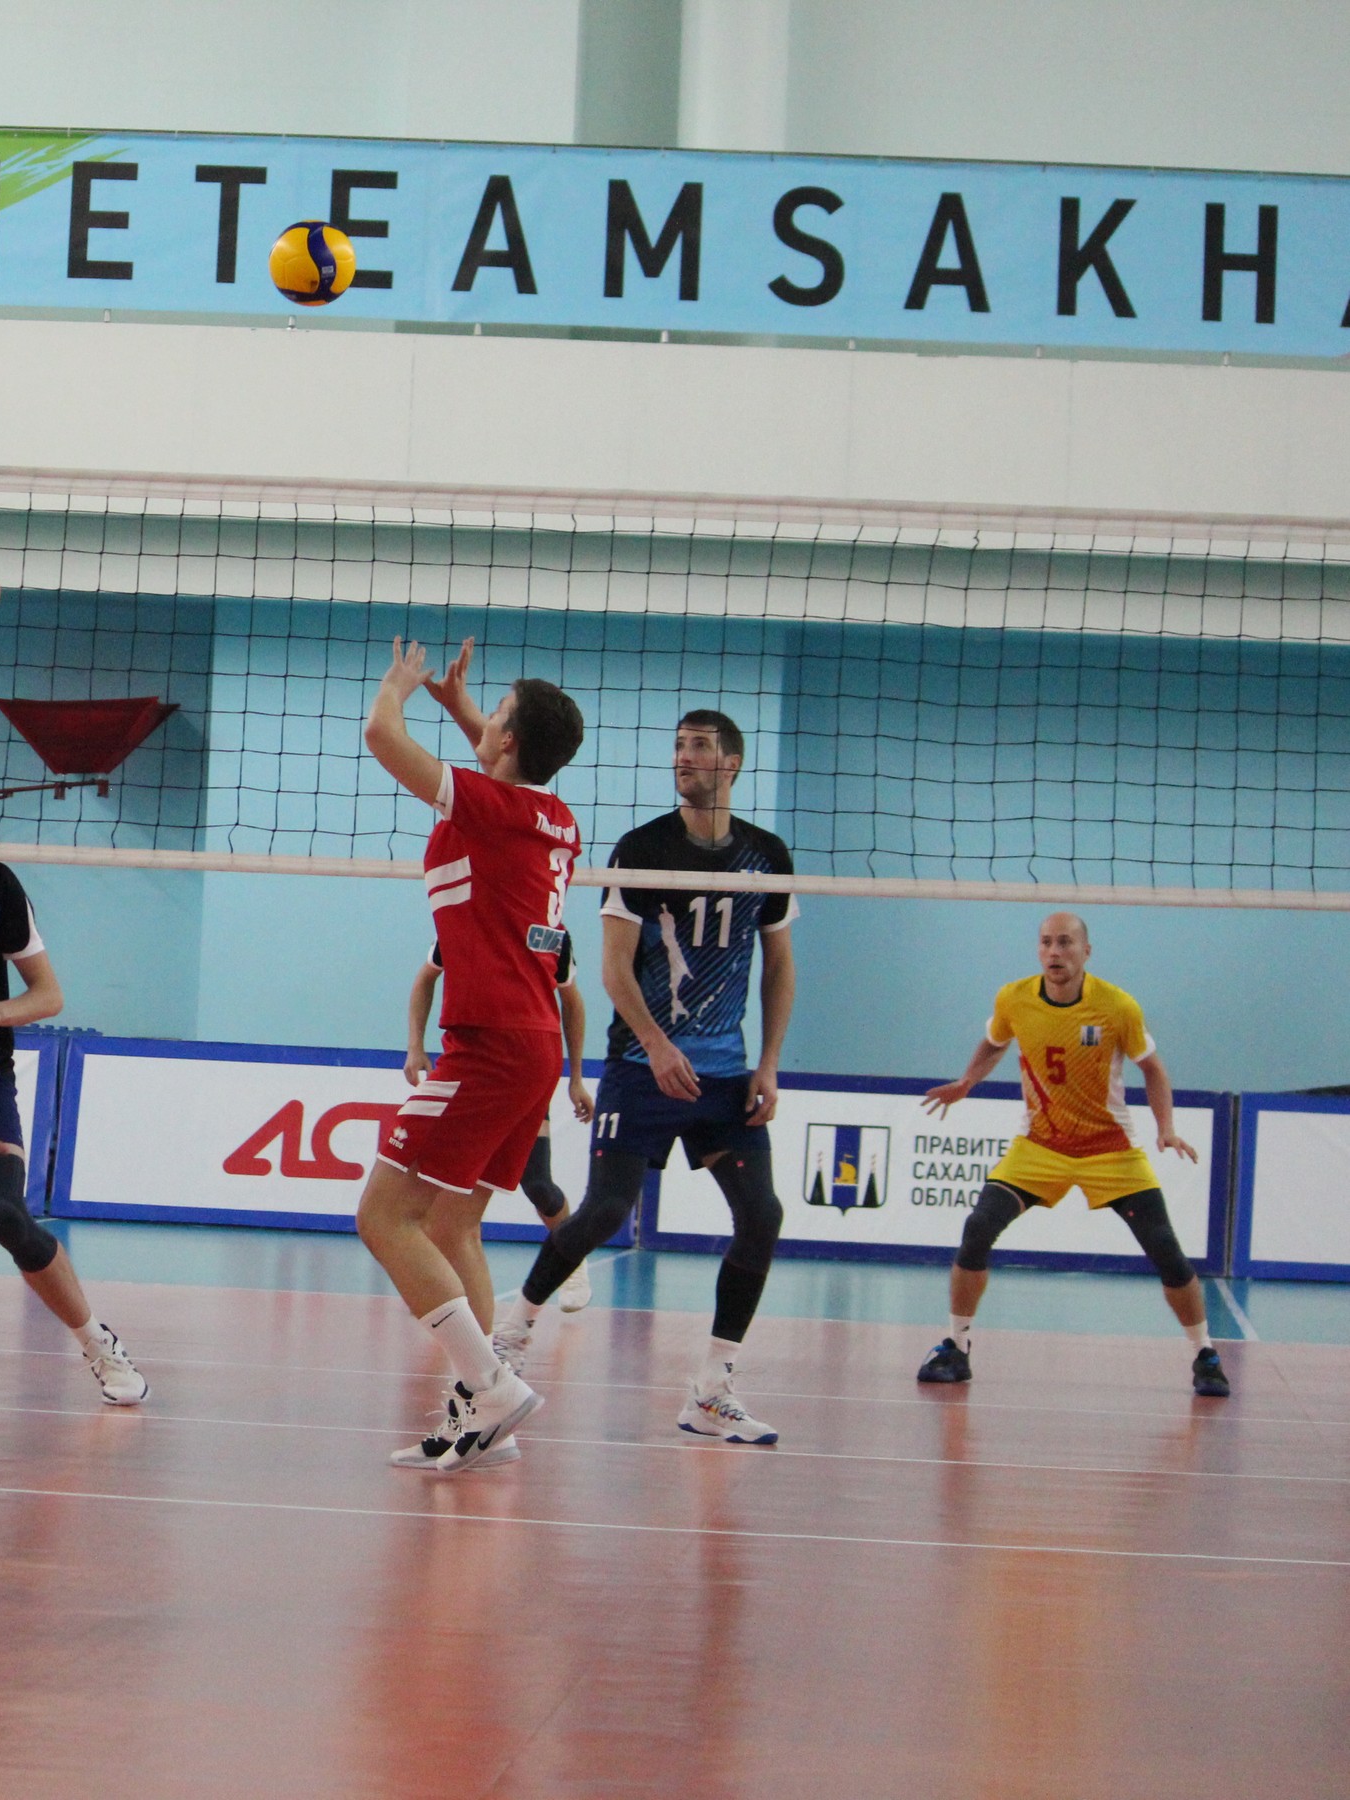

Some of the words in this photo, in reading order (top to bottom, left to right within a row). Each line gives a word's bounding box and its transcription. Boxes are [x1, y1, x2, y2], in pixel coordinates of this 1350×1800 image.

[689, 897, 733, 948] 11
[1046, 1046, 1066, 1085] 5
[597, 1113, 620, 1138] 11
[914, 1135, 1009, 1157] ПРАВИТЕ
[911, 1187, 980, 1208] ОБЛАС
